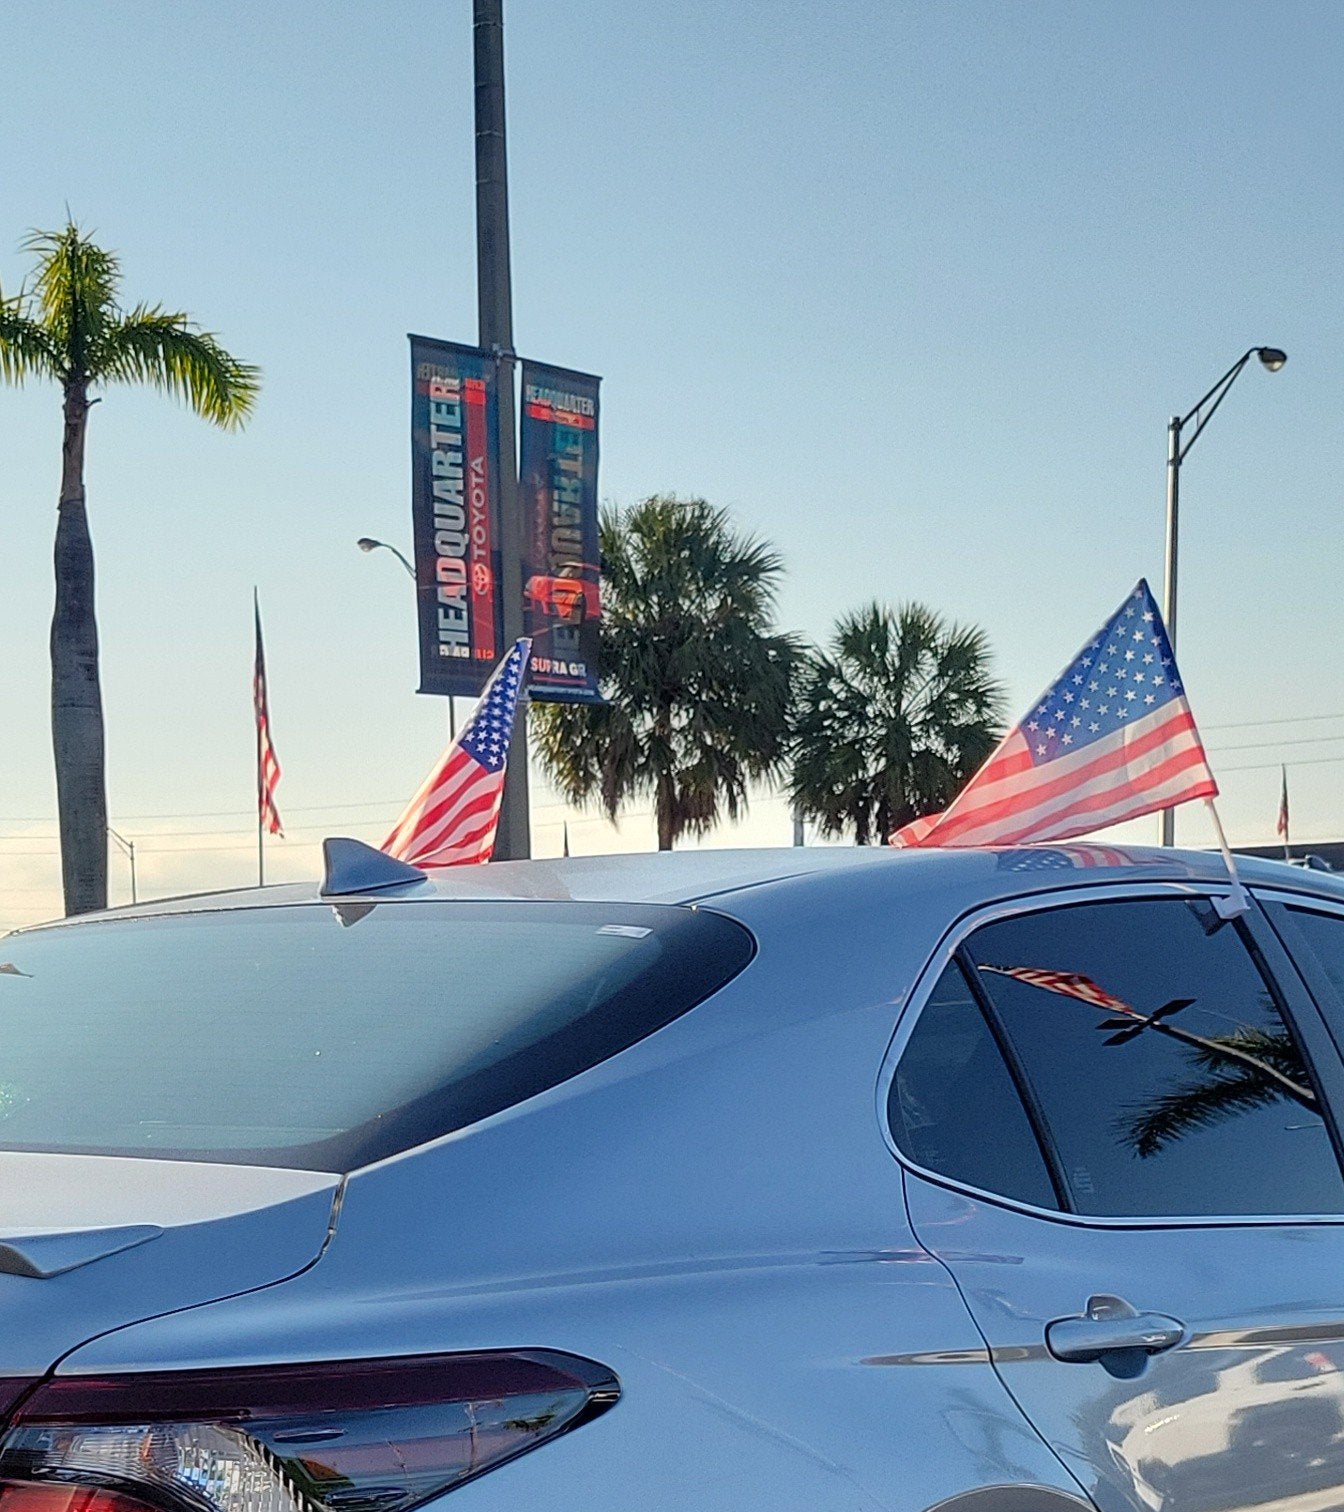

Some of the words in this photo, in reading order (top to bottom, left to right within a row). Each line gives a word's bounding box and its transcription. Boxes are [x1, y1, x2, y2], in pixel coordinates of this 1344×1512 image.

[430, 376, 469, 657] HEADQUARTER
[470, 456, 486, 560] TOYOTA
[531, 657, 567, 675] SUPRA
